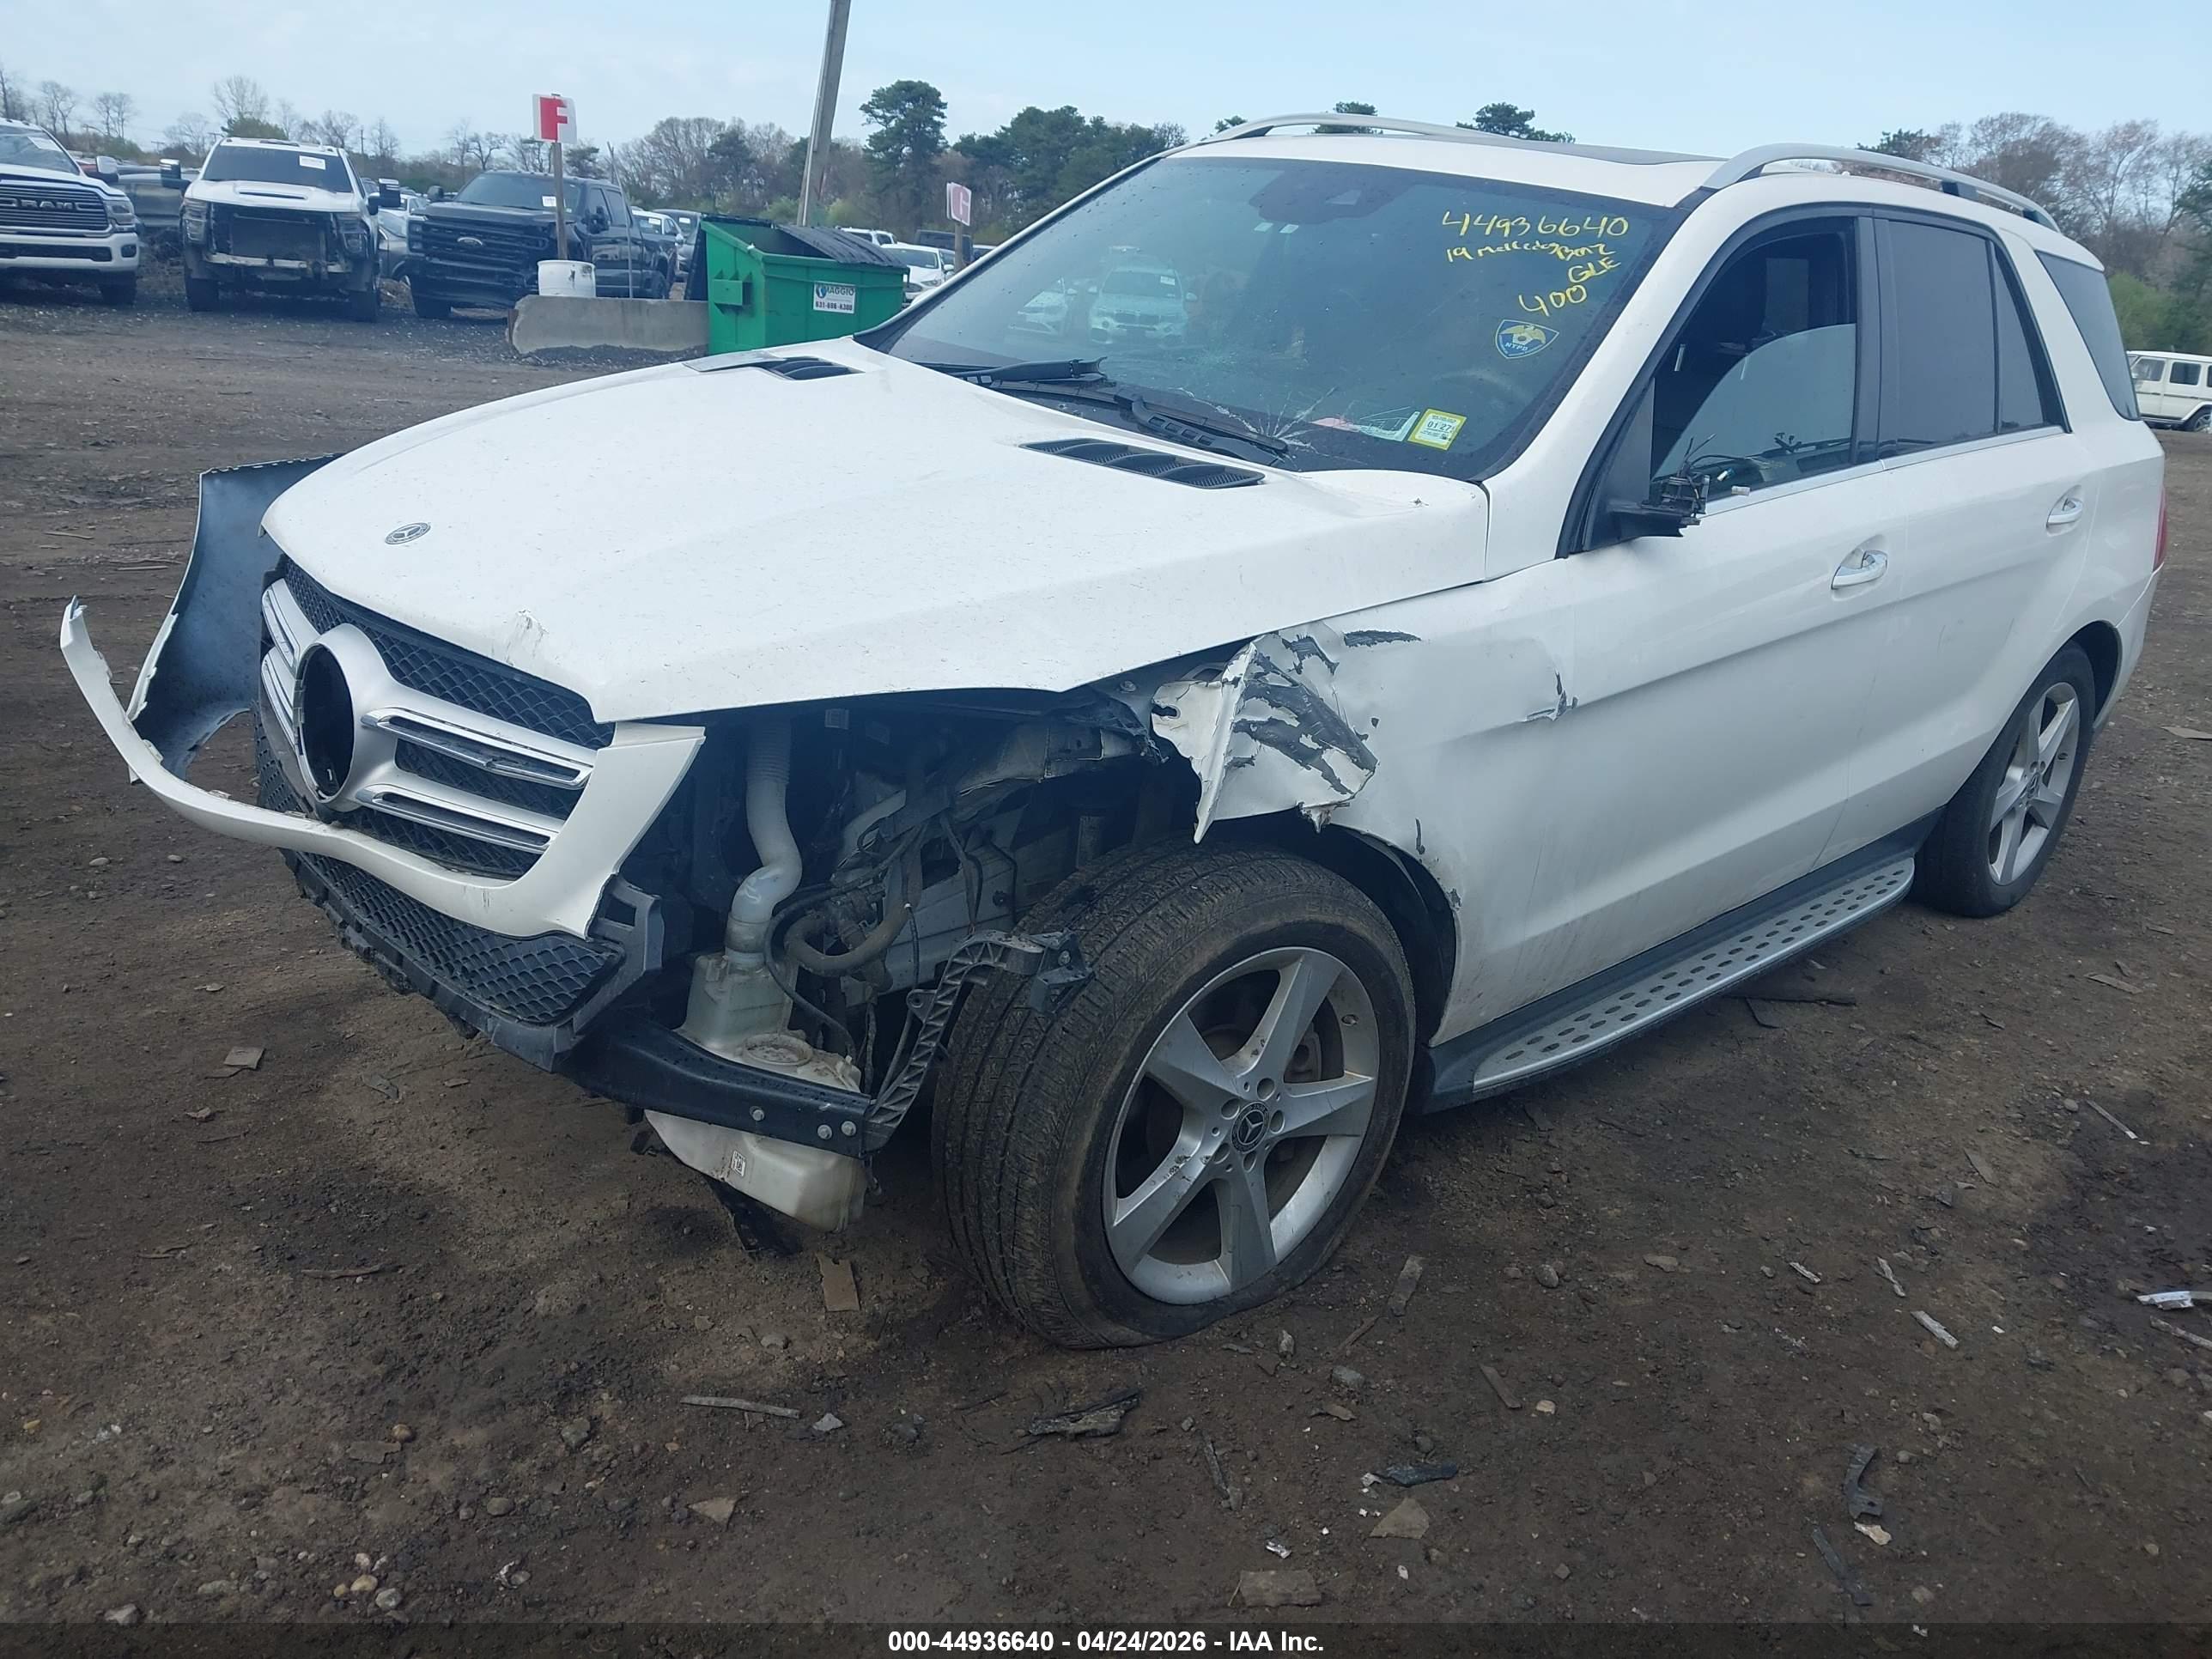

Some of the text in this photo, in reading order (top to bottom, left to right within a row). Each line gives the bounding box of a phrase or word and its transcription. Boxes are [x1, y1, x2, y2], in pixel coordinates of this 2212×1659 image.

[538, 96, 568, 140] F
[21, 199, 73, 209] RAM
[1443, 211, 1629, 238] 44936640
[1446, 247, 1474, 262] 19
[1568, 257, 1621, 283] GLE
[1518, 284, 1588, 317] 400
[1504, 342, 1528, 352] NYPD
